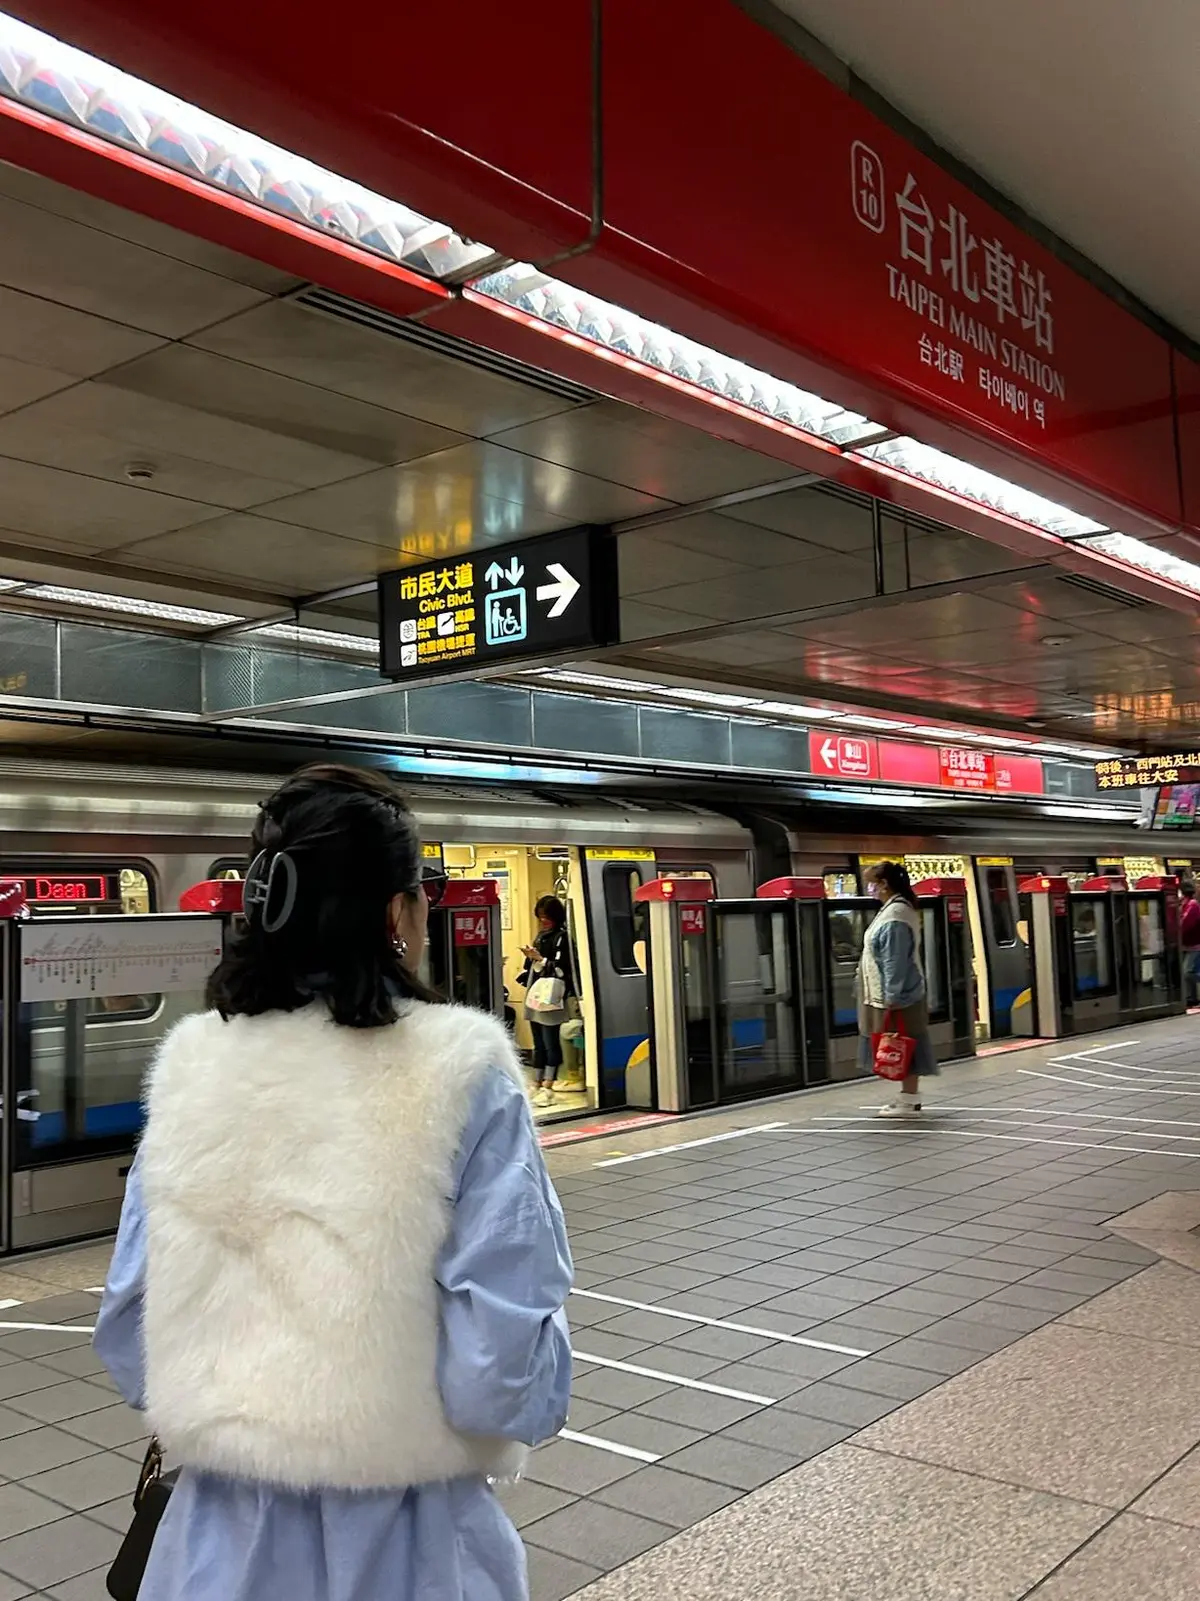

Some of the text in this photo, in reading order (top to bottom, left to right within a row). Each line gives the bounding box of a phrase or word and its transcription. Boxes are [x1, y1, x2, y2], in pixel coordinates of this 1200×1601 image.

[861, 156, 874, 188] R
[860, 189, 878, 221] 10
[895, 172, 1053, 354] 台北車站
[885, 263, 1065, 401] TAIPEI MAIN STATION
[1034, 399, 1045, 429] 역
[400, 562, 474, 600] 市民大道
[418, 590, 475, 614] Civic Blvd.
[1098, 769, 1179, 788] 本班車往大安
[36, 879, 86, 898] Daan
[475, 917, 487, 939] 4
[694, 910, 704, 929] 4
